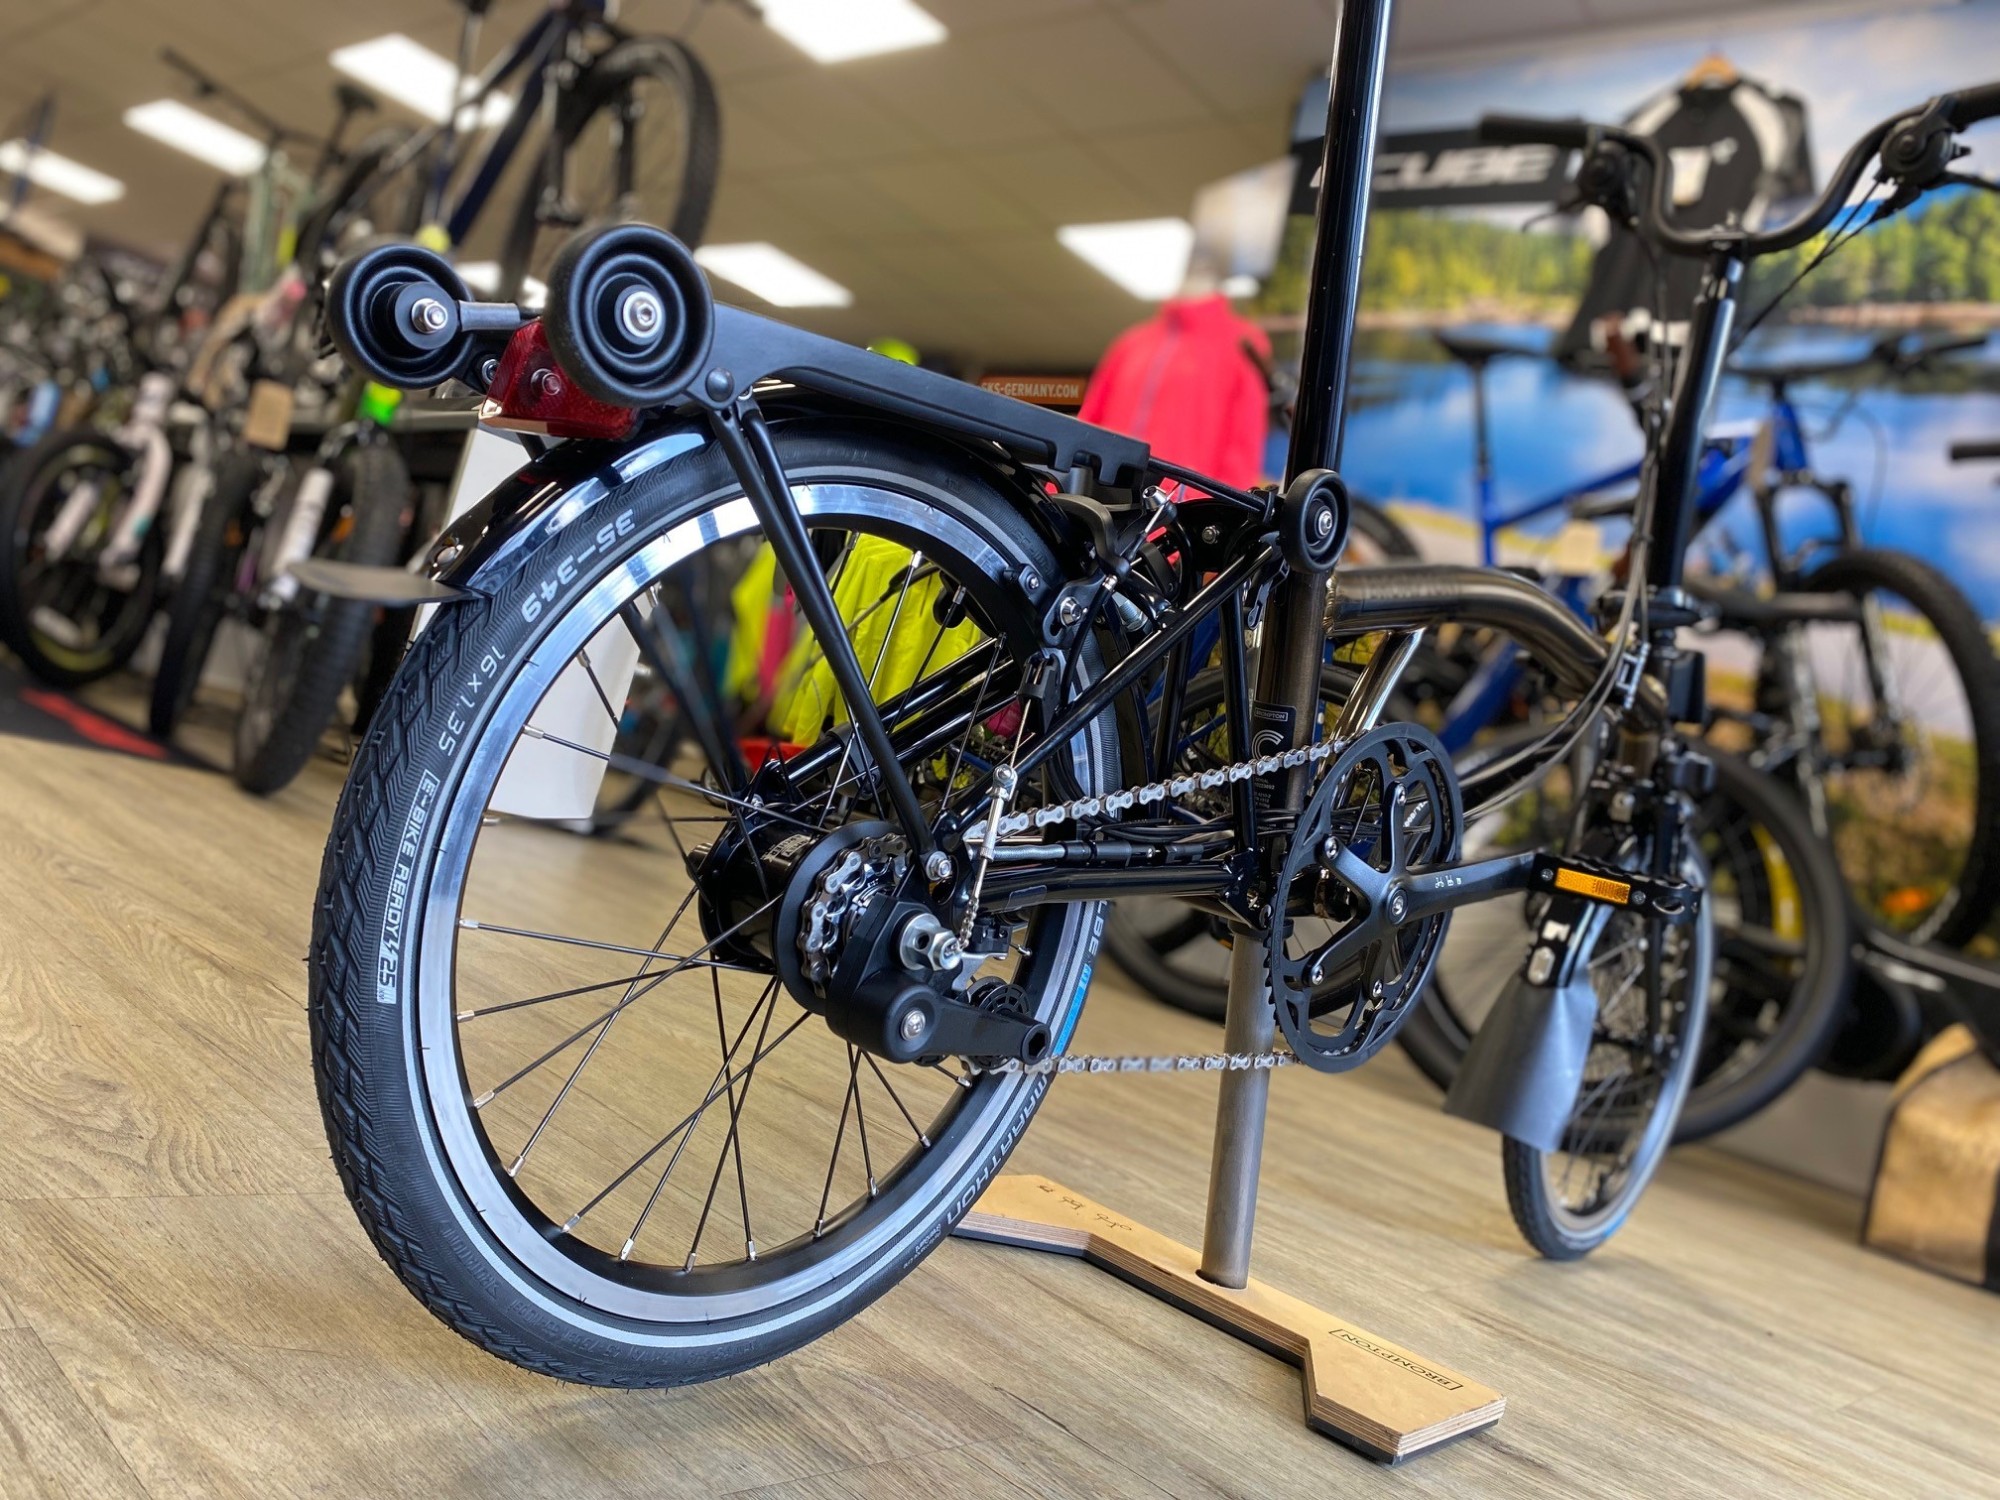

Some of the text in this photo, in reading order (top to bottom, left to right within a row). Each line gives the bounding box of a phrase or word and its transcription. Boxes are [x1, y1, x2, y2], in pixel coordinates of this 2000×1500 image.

[521, 508, 636, 623] 35-349
[402, 777, 436, 858] E-BIKE
[385, 862, 411, 939] READY
[379, 956, 397, 988] 25
[946, 1073, 1048, 1225] MARATHON
[1341, 1332, 1451, 1386] BROMPTON
